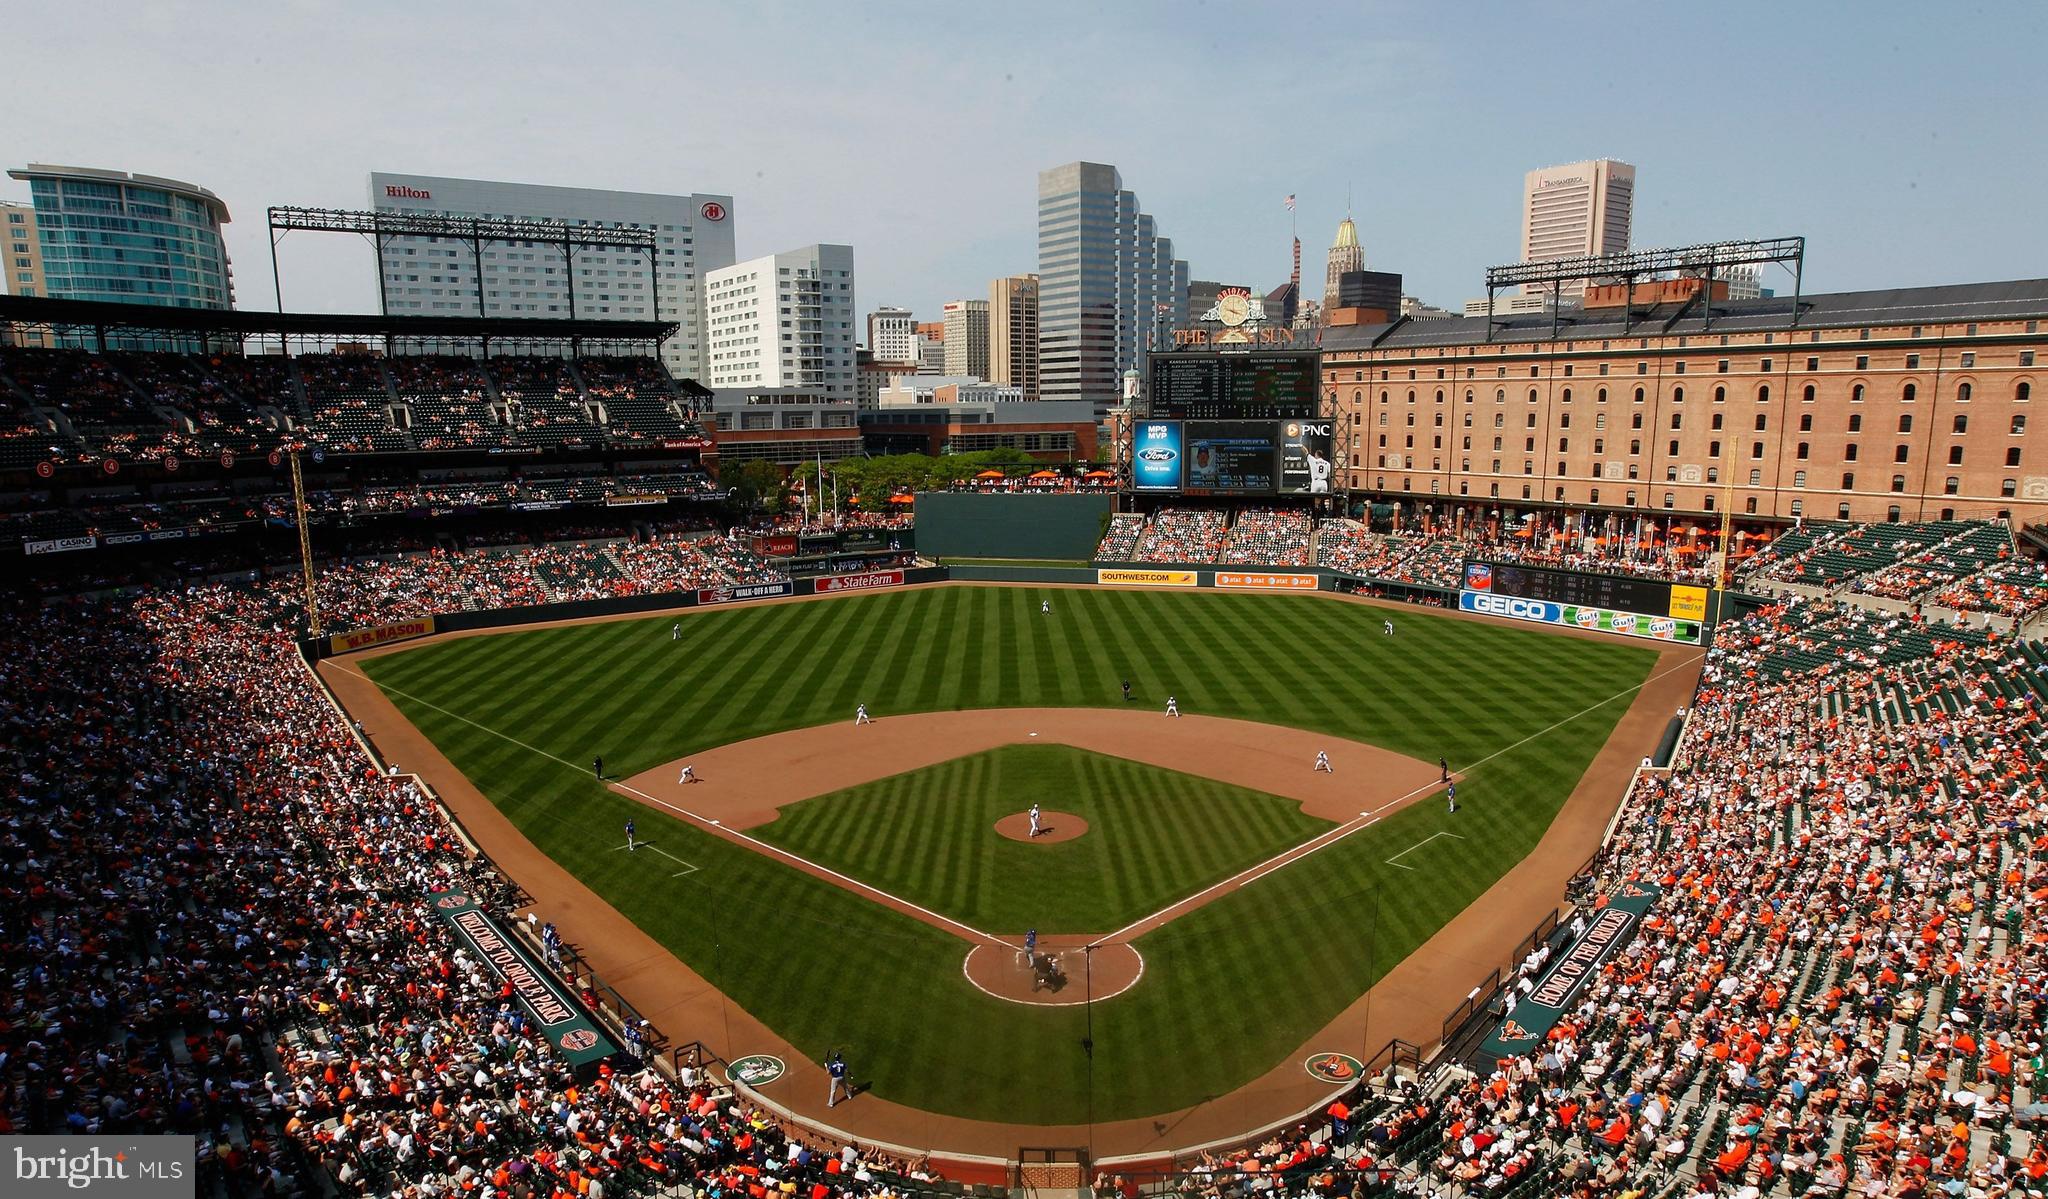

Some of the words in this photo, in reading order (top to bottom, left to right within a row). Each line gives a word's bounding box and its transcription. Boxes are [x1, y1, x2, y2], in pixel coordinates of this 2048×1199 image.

[385, 185, 431, 199] Hilton
[1216, 287, 1251, 300] ORIOLES
[1173, 328, 1207, 345] THE
[1260, 327, 1296, 343] SUN
[1147, 425, 1168, 433] MPG
[1301, 424, 1330, 436] PNC
[1147, 432, 1168, 440] MVP
[314, 453, 324, 461] 42
[1145, 449, 1170, 460] Ford
[167, 459, 177, 467] 22
[106, 534, 142, 544] GEICO
[150, 530, 184, 540] GEICO
[60, 538, 92, 547] CASINO
[773, 544, 794, 552] REACH
[1102, 572, 1169, 581] SOUTHWEST.COM
[736, 587, 764, 597] WALK-OFF
[769, 585, 784, 595] HERO
[1473, 595, 1546, 619] GEICO
[1577, 611, 1598, 621] Gulf
[1612, 616, 1635, 627] Gulf
[1650, 620, 1675, 631] Gulf
[346, 633, 375, 648] W.B.
[376, 623, 425, 640] MASON
[1587, 910, 1629, 943] ORIOLES
[1575, 942, 1603, 962] THE
[457, 912, 504, 952] WELCOME
[502, 963, 546, 998] ORIOLE
[531, 994, 570, 1024] PARK
[1560, 961, 1586, 976] OF
[1533, 974, 1576, 1006] HOME
